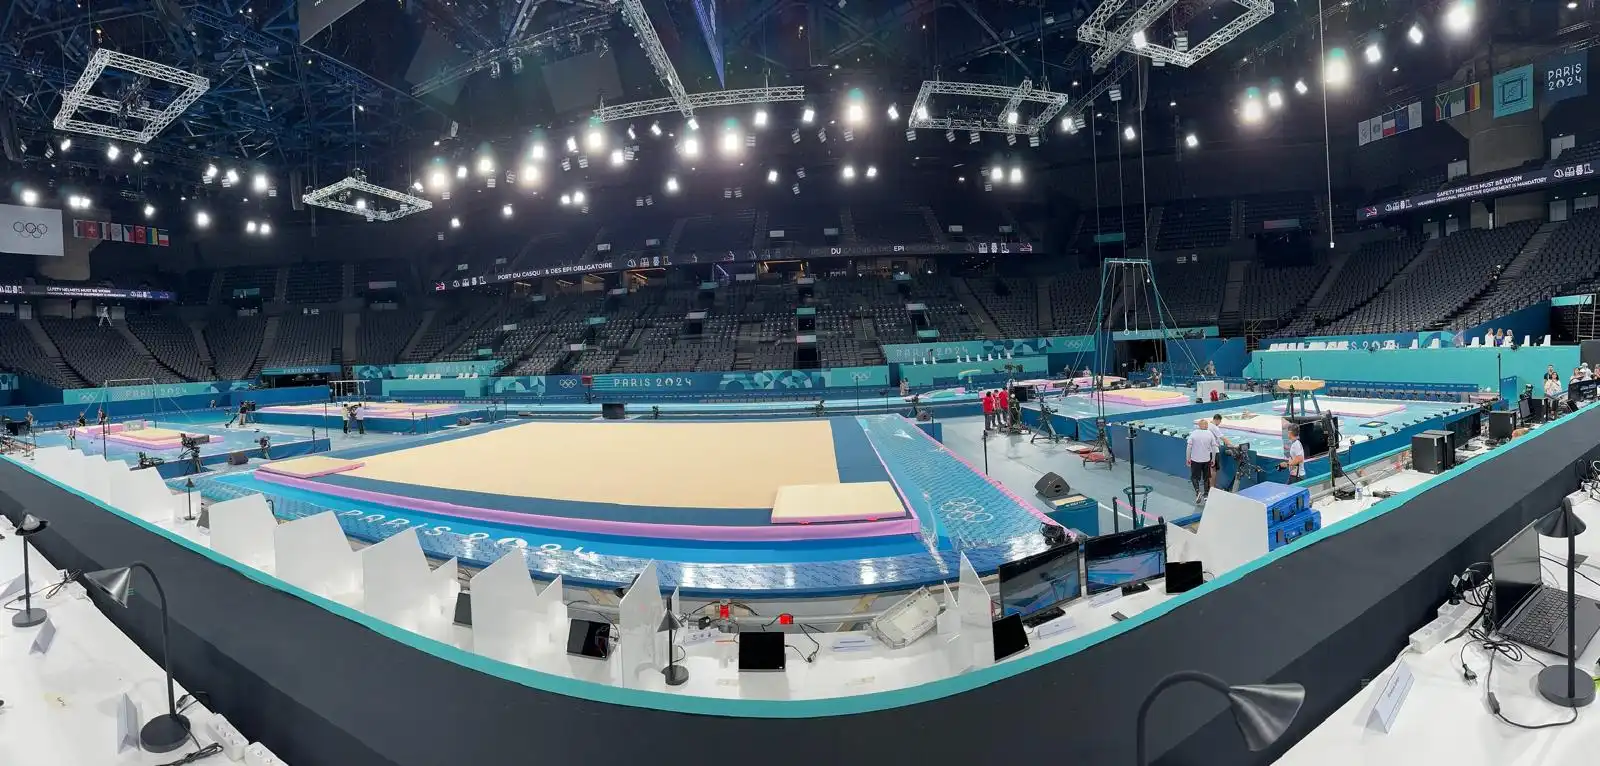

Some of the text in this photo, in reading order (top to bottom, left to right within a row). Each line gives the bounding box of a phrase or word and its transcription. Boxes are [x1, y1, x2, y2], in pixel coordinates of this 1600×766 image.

[1548, 63, 1582, 80] PARIS
[1548, 75, 1582, 91] 2024
[1436, 175, 1523, 198] SAFETY HELMETS MUST BE WORN
[572, 262, 613, 272] OBLIGATOIRE
[613, 377, 692, 388] PARIS 2024
